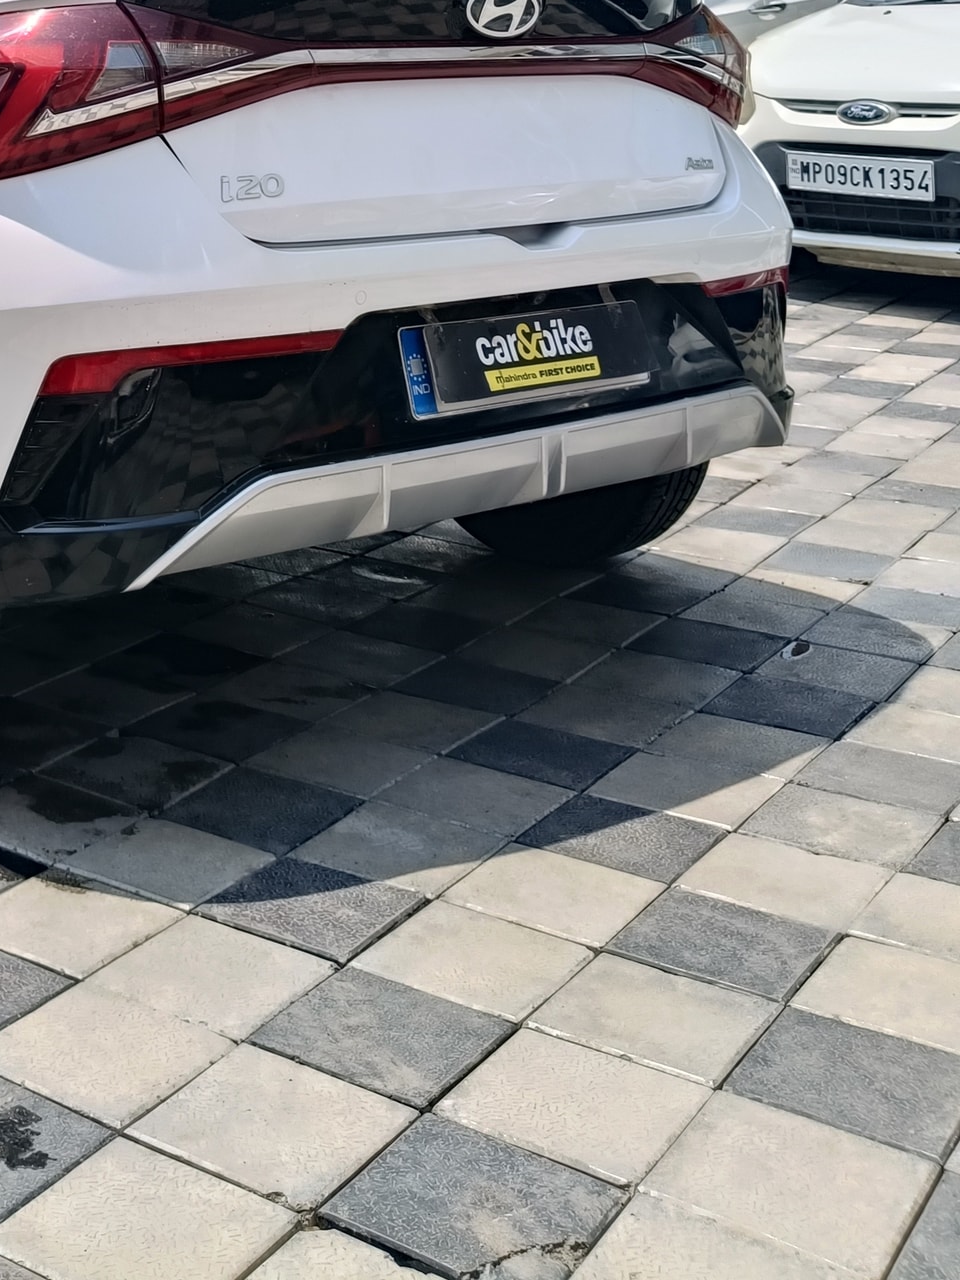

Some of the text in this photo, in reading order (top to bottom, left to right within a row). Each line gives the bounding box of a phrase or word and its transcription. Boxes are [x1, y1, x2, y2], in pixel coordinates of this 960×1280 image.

[847, 103, 878, 119] Ford
[800, 160, 930, 194] MP09CK1354
[475, 318, 594, 367] car&bike
[538, 367, 564, 379] FIRST
[565, 362, 596, 375] CHOICE
[412, 383, 431, 396] IND
